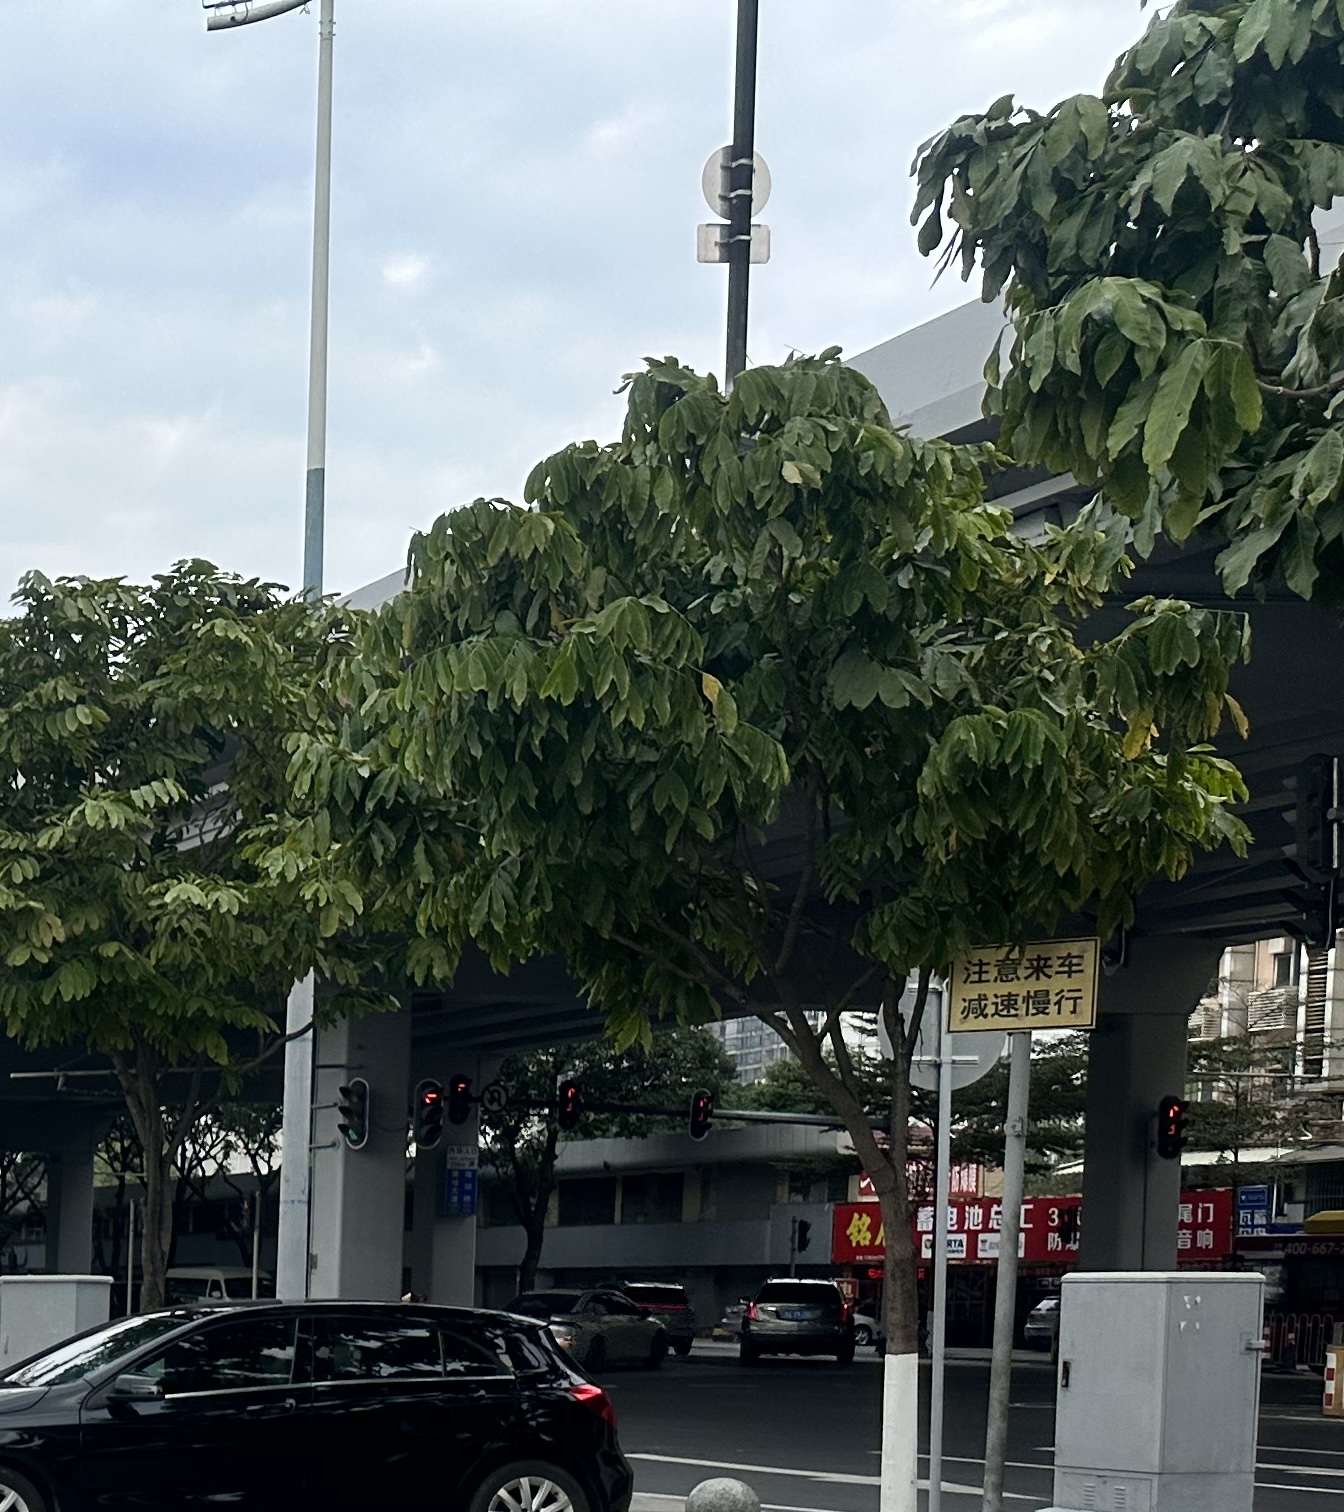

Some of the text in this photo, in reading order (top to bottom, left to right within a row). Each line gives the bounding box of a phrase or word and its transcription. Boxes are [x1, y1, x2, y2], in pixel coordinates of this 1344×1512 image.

[963, 952, 1085, 985] 注意来车
[960, 988, 1084, 1020] 减速慢行
[1177, 1229, 1214, 1250] 音响
